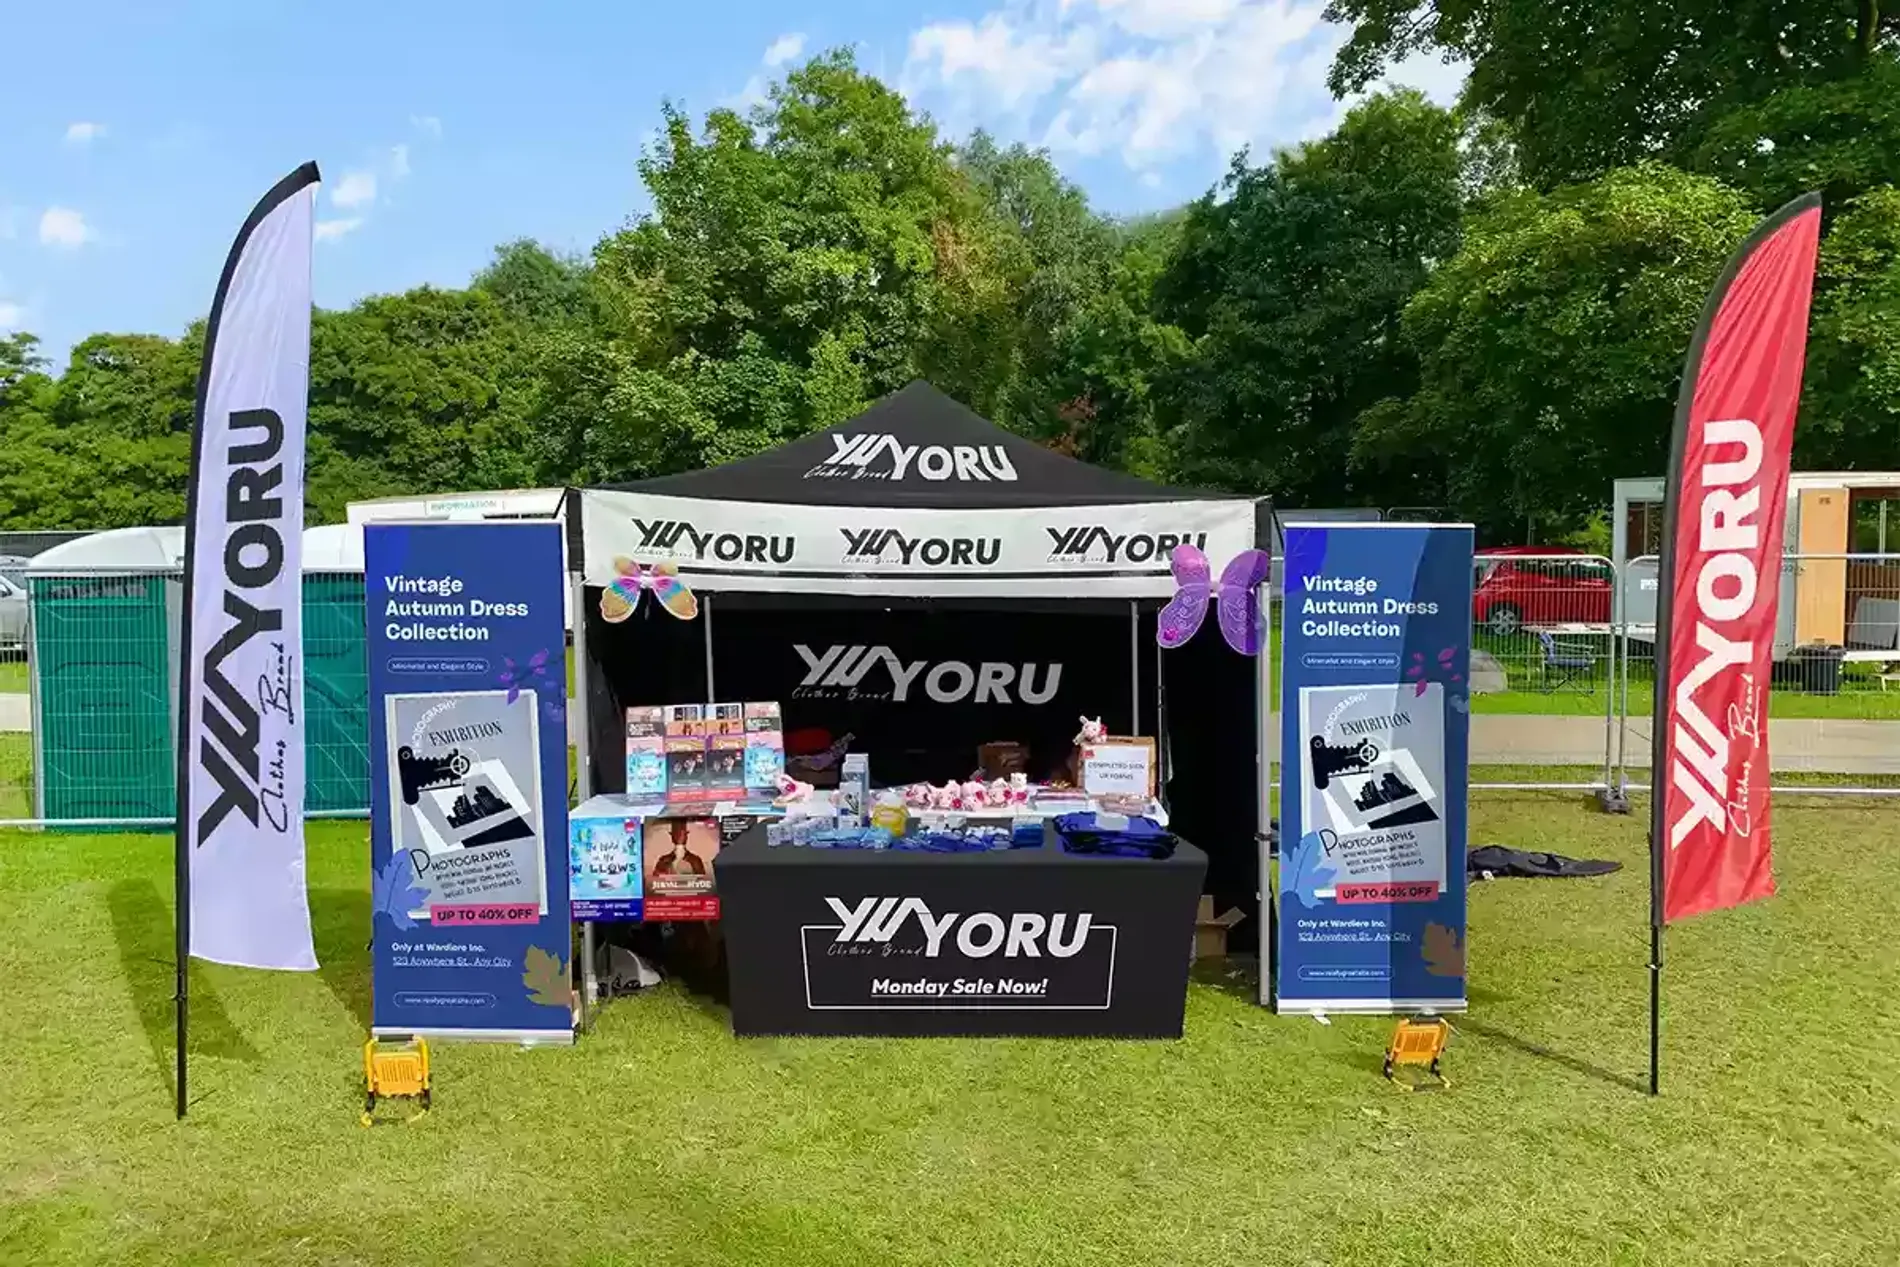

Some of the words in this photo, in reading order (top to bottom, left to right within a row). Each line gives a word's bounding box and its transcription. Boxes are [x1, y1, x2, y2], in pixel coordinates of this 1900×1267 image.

[384, 575, 464, 597] Vintage
[1302, 575, 1378, 596] Vintage
[384, 600, 464, 617] Autumn
[470, 602, 529, 617] Dress
[1302, 598, 1378, 614] Autumn
[1384, 600, 1439, 614] Dress
[386, 623, 489, 641] Collection
[1302, 620, 1401, 637] Collection
[258, 641, 296, 726] Brand
[1729, 673, 1762, 749] Brand
[428, 718, 503, 747] EXHIBITION
[1340, 711, 1412, 736] EXHIBITION
[1318, 828, 1415, 858] PHOTOGRAPHS
[410, 849, 511, 880] PHOTOGRAPHS
[1342, 889, 1359, 899] UP
[1361, 888, 1378, 898] TO
[1381, 887, 1406, 898] 40%
[1409, 887, 1432, 897] OFF
[437, 911, 455, 921] UP
[459, 910, 475, 920] TO
[478, 909, 504, 920] 40%
[508, 908, 533, 919] OFF
[1297, 919, 1317, 929] Only
[1319, 920, 1329, 928] at
[1392, 932, 1412, 942] City
[391, 942, 412, 954] Only
[413, 943, 424, 952] at
[493, 956, 512, 968] City
[871, 977, 949, 997] Monday
[952, 978, 994, 994] Sale
[997, 977, 1049, 994] Now!
